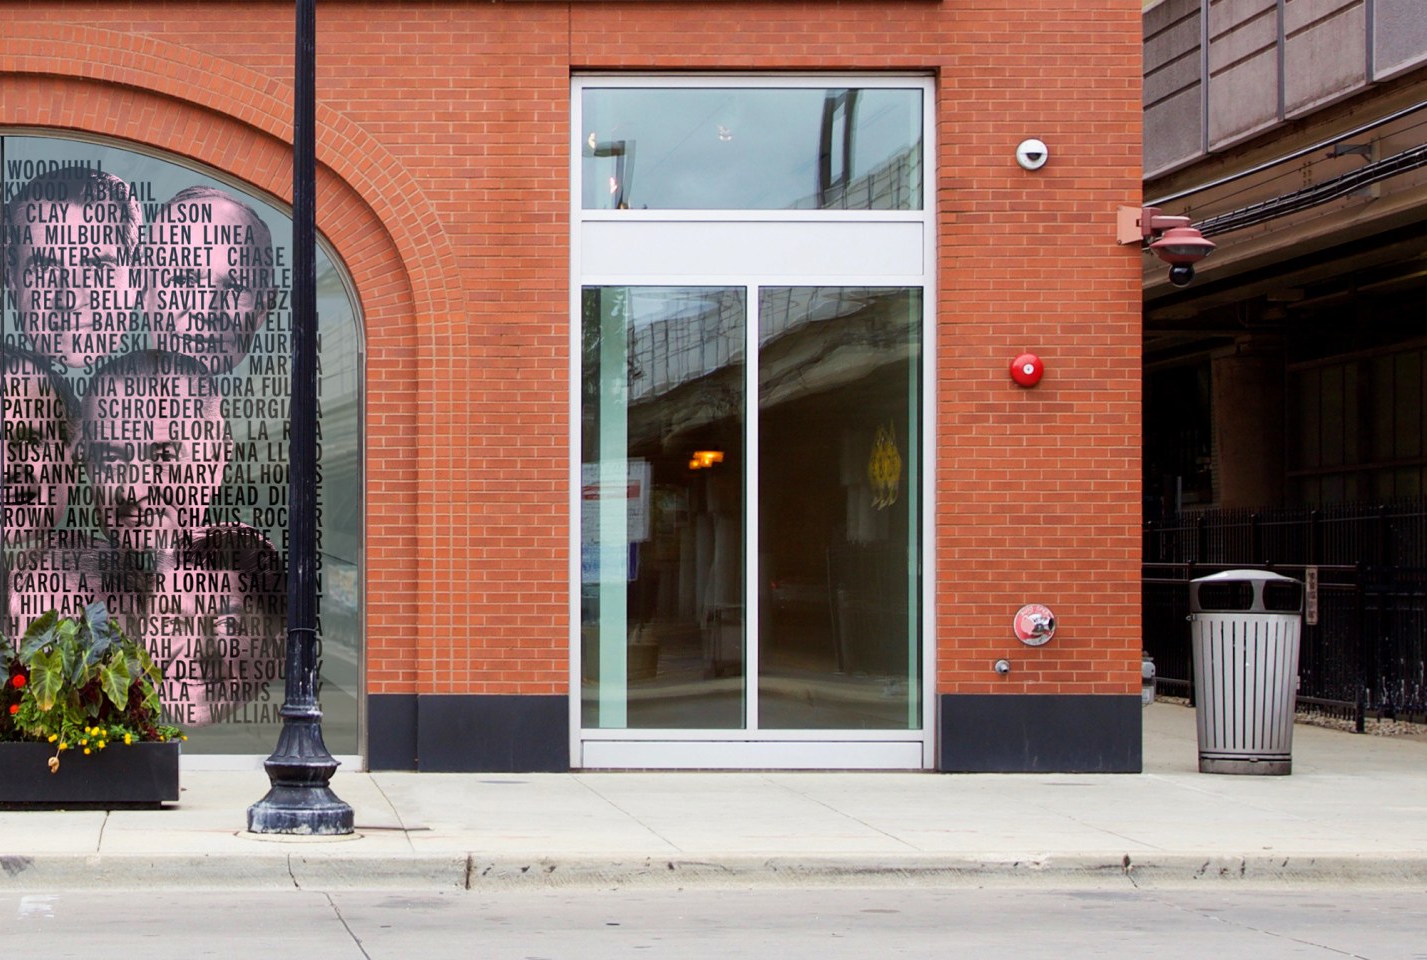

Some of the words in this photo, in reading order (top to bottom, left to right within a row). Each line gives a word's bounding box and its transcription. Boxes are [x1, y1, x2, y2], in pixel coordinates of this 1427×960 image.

[8, 160, 103, 180] WOODHULL
[84, 181, 156, 202] ABIGAIL
[26, 203, 68, 223] CLAY
[83, 203, 130, 223] CORA
[145, 203, 212, 223] WILSON
[45, 225, 124, 245] MILBURN
[138, 225, 192, 245] ELLEN
[203, 225, 255, 245] LINEA
[32, 247, 101, 267] WATERS
[116, 247, 214, 267] MARGARET
[227, 247, 285, 267] CHASE
[23, 268, 116, 289] CHARLENE
[129, 268, 216, 289] MITCHELL
[31, 290, 76, 310] REED
[90, 290, 145, 310] BELLA
[157, 290, 241, 310] SAVITZKY
[13, 312, 82, 332] WRIGHT
[93, 312, 176, 332] BARBARA
[185, 312, 256, 332] JORDAN
[72, 334, 149, 354] KANESKI
[157, 334, 228, 354] HORBAL
[83, 355, 139, 376] SONIA
[152, 355, 233, 376] JOHNSON
[124, 377, 180, 398] BURKE
[188, 377, 253, 398] LENORA
[98, 399, 204, 419] SCHROEDER
[81, 421, 154, 441] KILLEEN
[168, 421, 232, 441] GLORIA
[248, 421, 268, 441] LA
[7, 443, 65, 463] SUSAN
[192, 443, 258, 463] ELVENA
[39, 464, 85, 485] ANNE
[92, 464, 163, 485] HARDER
[168, 464, 217, 485] MARY
[223, 464, 255, 485] CAL
[67, 486, 137, 506] MONICA
[148, 486, 258, 506] MOOREHEAD
[66, 508, 124, 528] ANGEL
[135, 508, 166, 528] JOY
[178, 508, 241, 528] CHAVIS
[3, 530, 106, 550] KATHERINE
[111, 530, 192, 550] BATEMAN
[204, 530, 271, 550] JOANNE
[2, 551, 81, 572] MOSELEY
[98, 551, 157, 572] BRAUN
[174, 551, 241, 572] JEANNE
[14, 573, 70, 593] CAROL
[78, 573, 93, 593] A.
[101, 573, 165, 593] MILLER
[174, 573, 231, 593] LORNA
[107, 595, 182, 615] CLINTON
[195, 595, 230, 615] NAN
[127, 617, 220, 637] ROSEANNE
[226, 617, 267, 637] BARR
[174, 660, 248, 681] DEVILLE
[205, 682, 271, 702] HARRIS
